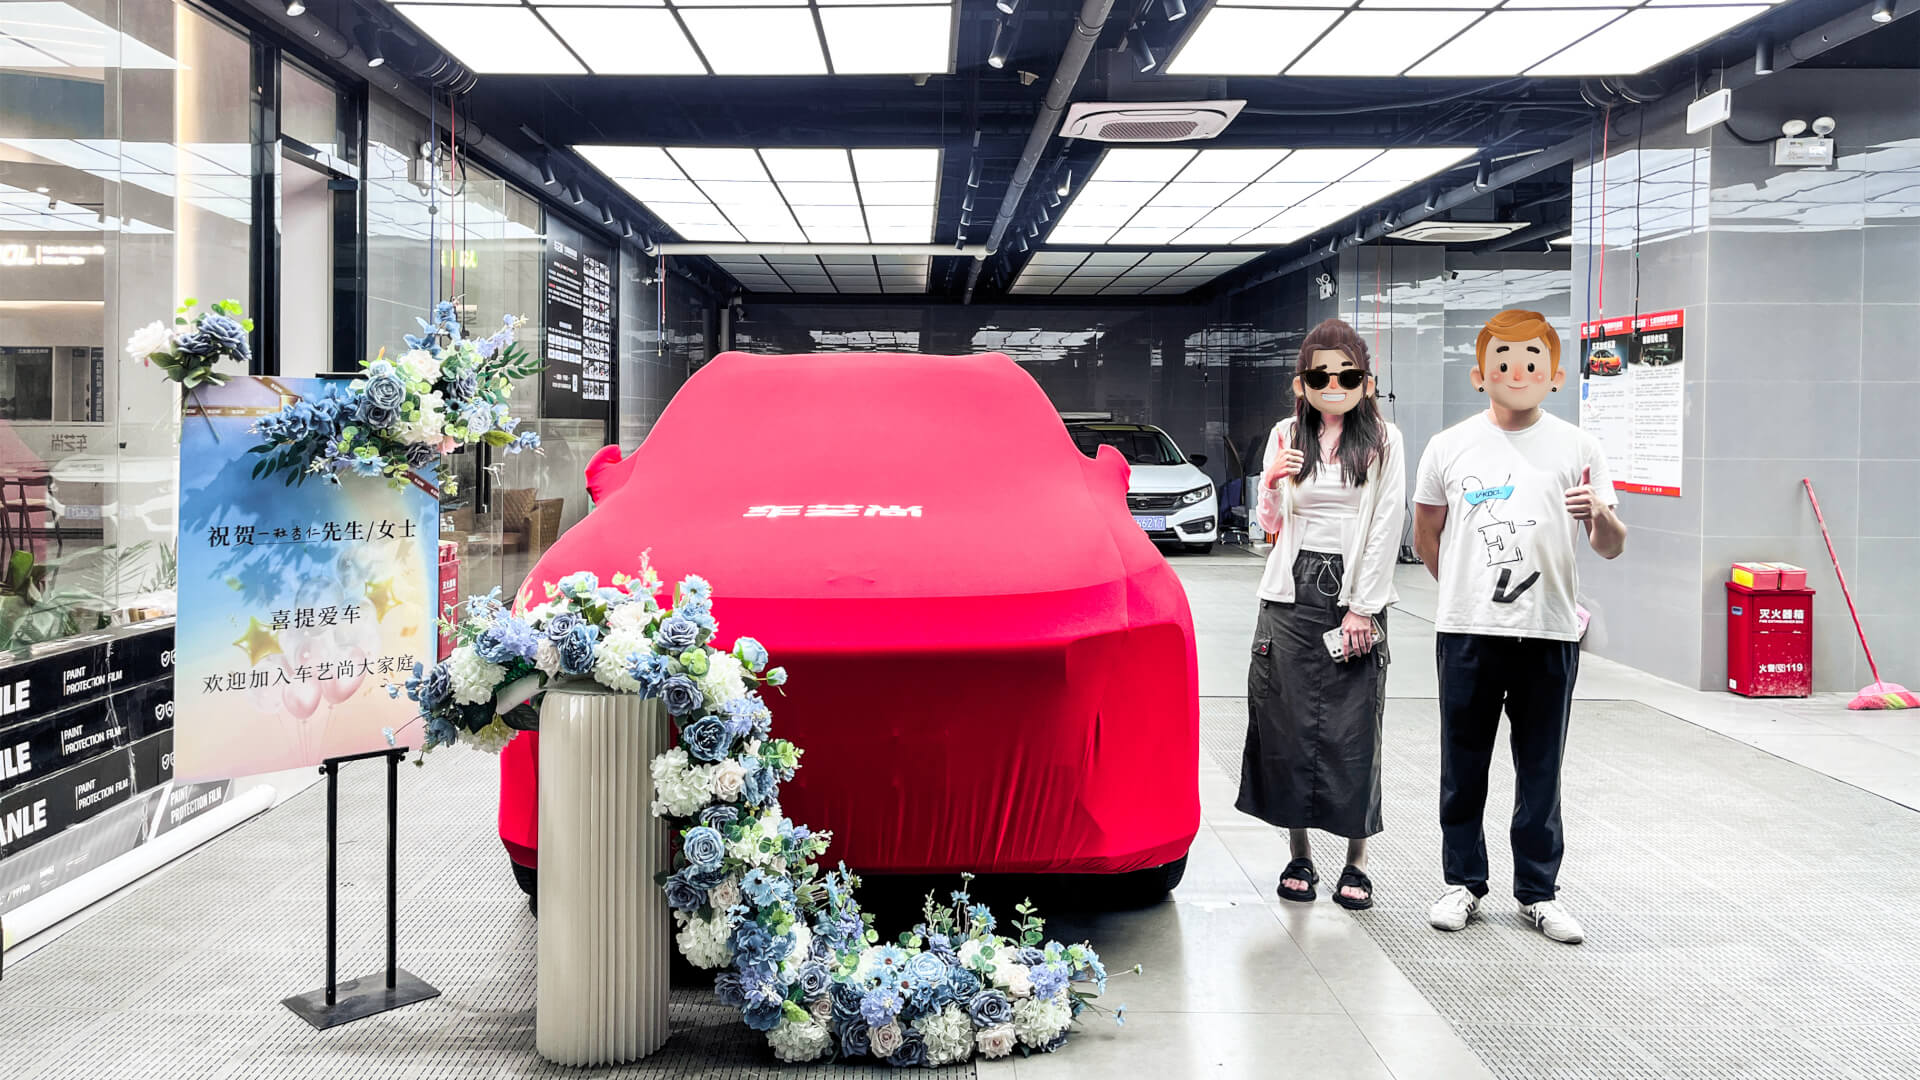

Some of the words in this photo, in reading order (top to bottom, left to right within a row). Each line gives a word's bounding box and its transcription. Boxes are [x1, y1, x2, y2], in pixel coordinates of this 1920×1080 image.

[270, 604, 361, 631] 喜提爱车
[1759, 608, 1804, 620] 灭火器箱
[66, 666, 87, 681] PAINT
[66, 675, 106, 696] PROTECTION
[107, 669, 123, 683] FILM
[202, 653, 415, 694] 欢迎加入车艺尚大家庭
[0, 679, 31, 717] LE
[64, 724, 84, 740] PAINT
[65, 732, 105, 754] PROTECTION
[106, 725, 122, 740] FILM
[0, 740, 32, 782] LE
[78, 778, 97, 795] PAINT
[78, 786, 114, 810] PROTECTION
[115, 778, 129, 793] FILM
[170, 784, 189, 807] PAINT
[170, 795, 208, 825] PROTECTION
[208, 786, 222, 805] FILM
